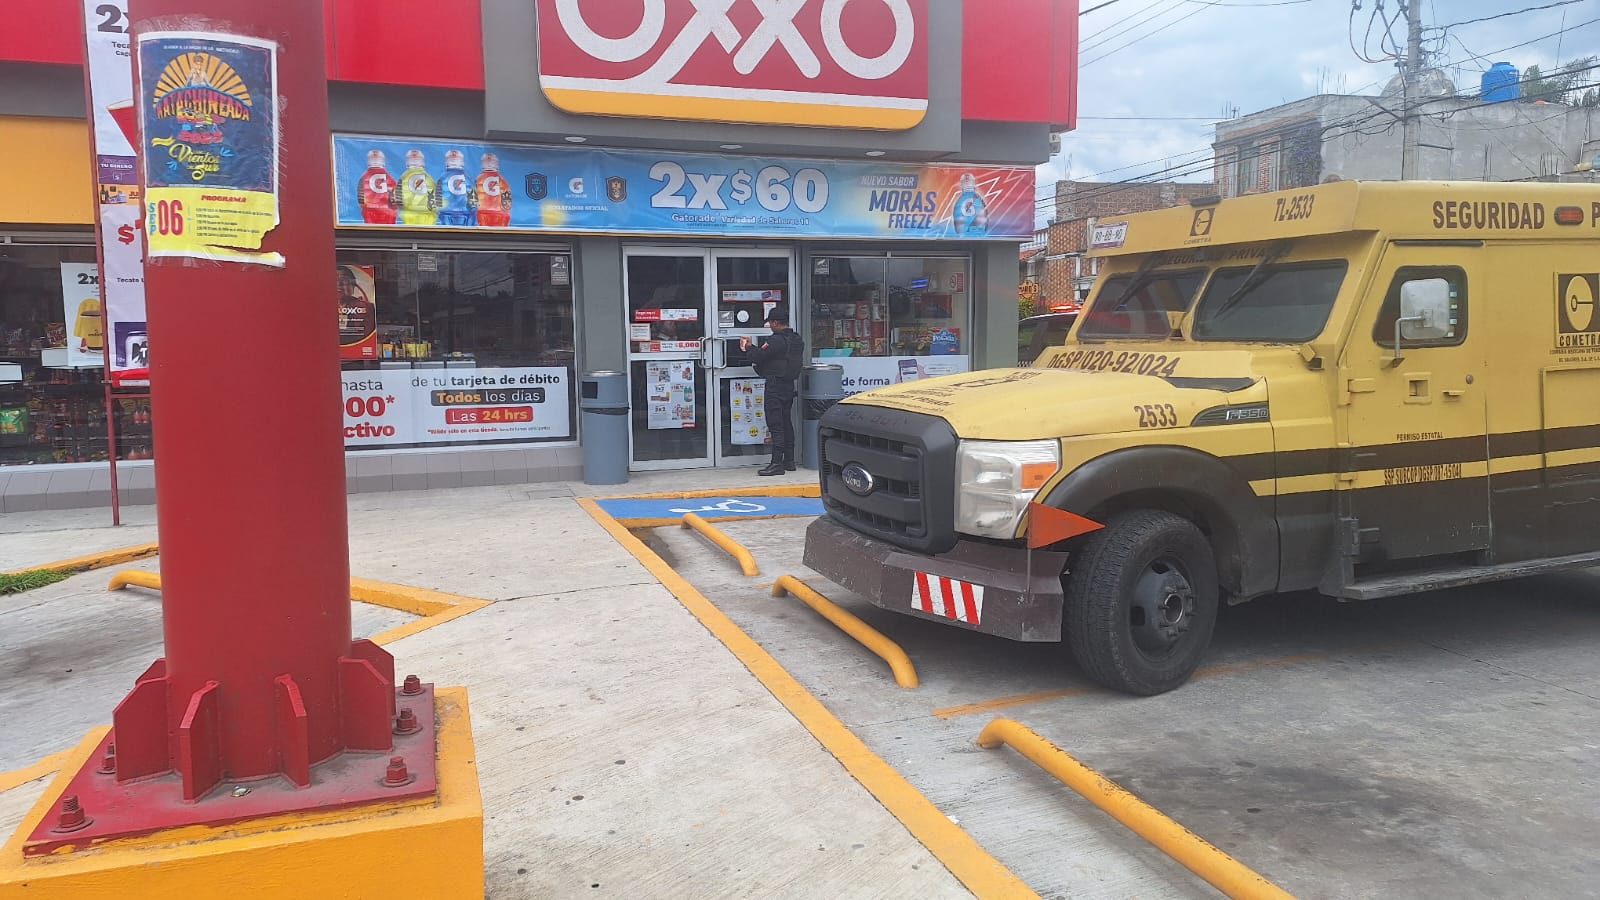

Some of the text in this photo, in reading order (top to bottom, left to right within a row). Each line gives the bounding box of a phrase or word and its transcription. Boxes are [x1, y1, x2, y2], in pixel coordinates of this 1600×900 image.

[555, 0, 915, 82] OXXO
[648, 160, 830, 215] 2x$60
[861, 175, 915, 187] NUEVO SABOR
[201, 194, 247, 203] PROGRAMA
[868, 189, 937, 214] MORAS
[1273, 194, 1316, 222] TL-2533
[1432, 200, 1546, 230] SEGURIDAD
[157, 199, 184, 236] 06
[671, 212, 716, 223] Gatorade
[721, 215, 756, 224] Variedad
[888, 212, 933, 230] FREEZE
[411, 376, 428, 388] de
[433, 376, 447, 387] tu
[450, 374, 496, 389] tarjeta
[499, 373, 516, 386] de
[518, 372, 560, 385] débito
[841, 376, 891, 387] de forma
[436, 391, 481, 404] Todos
[485, 389, 507, 402] los
[511, 389, 541, 401] días
[452, 408, 528, 423] Las 24 hrs
[1133, 403, 1178, 428] 2533
[1396, 433, 1420, 441] PERMISO
